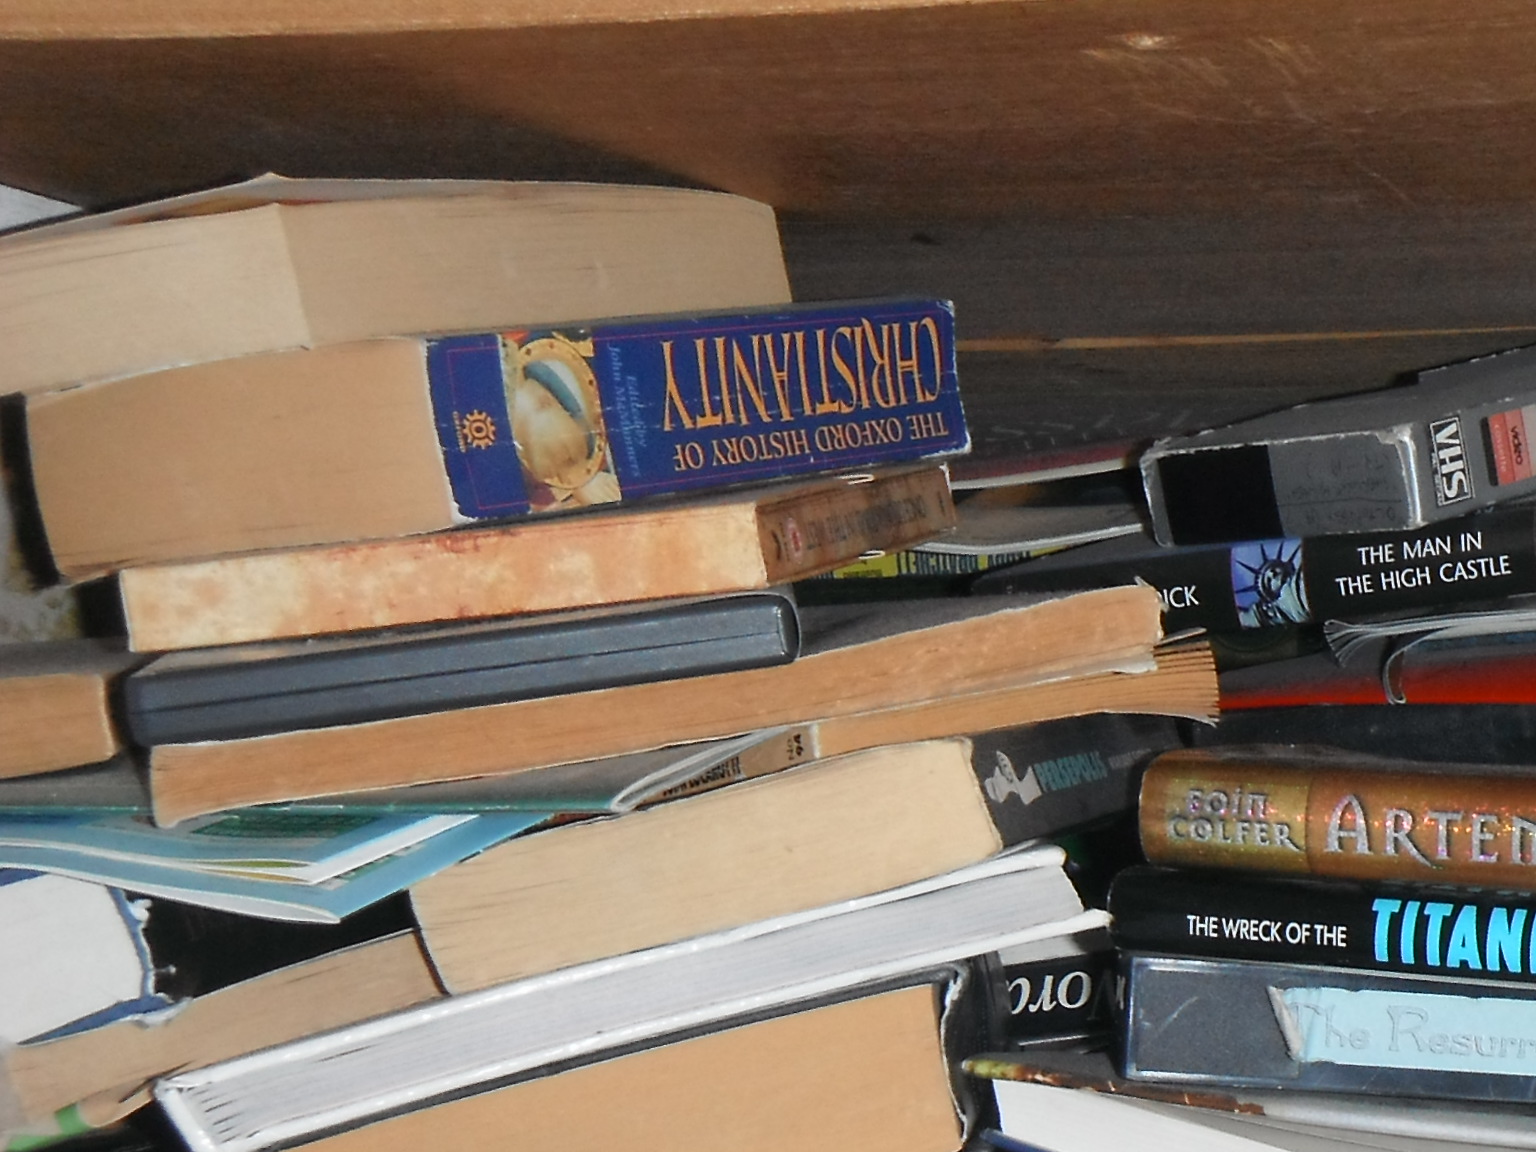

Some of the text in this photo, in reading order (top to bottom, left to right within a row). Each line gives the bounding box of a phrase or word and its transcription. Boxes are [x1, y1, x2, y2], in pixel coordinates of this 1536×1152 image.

[662, 316, 942, 431] CHRISTIANITY
[673, 412, 949, 471] THE OXFORD HISTORY OF
[1434, 417, 1467, 502] VHS
[1508, 424, 1524, 466] video
[1357, 532, 1484, 567] THE MAN IN
[1335, 554, 1513, 598] THE HIGH CASTLE
[1167, 816, 1304, 852] COLFER
[1187, 914, 1218, 938] THE
[1222, 918, 1282, 943] WRECK
[1285, 922, 1311, 945] OF
[1315, 924, 1347, 948] THE
[1288, 1002, 1370, 1052] The
